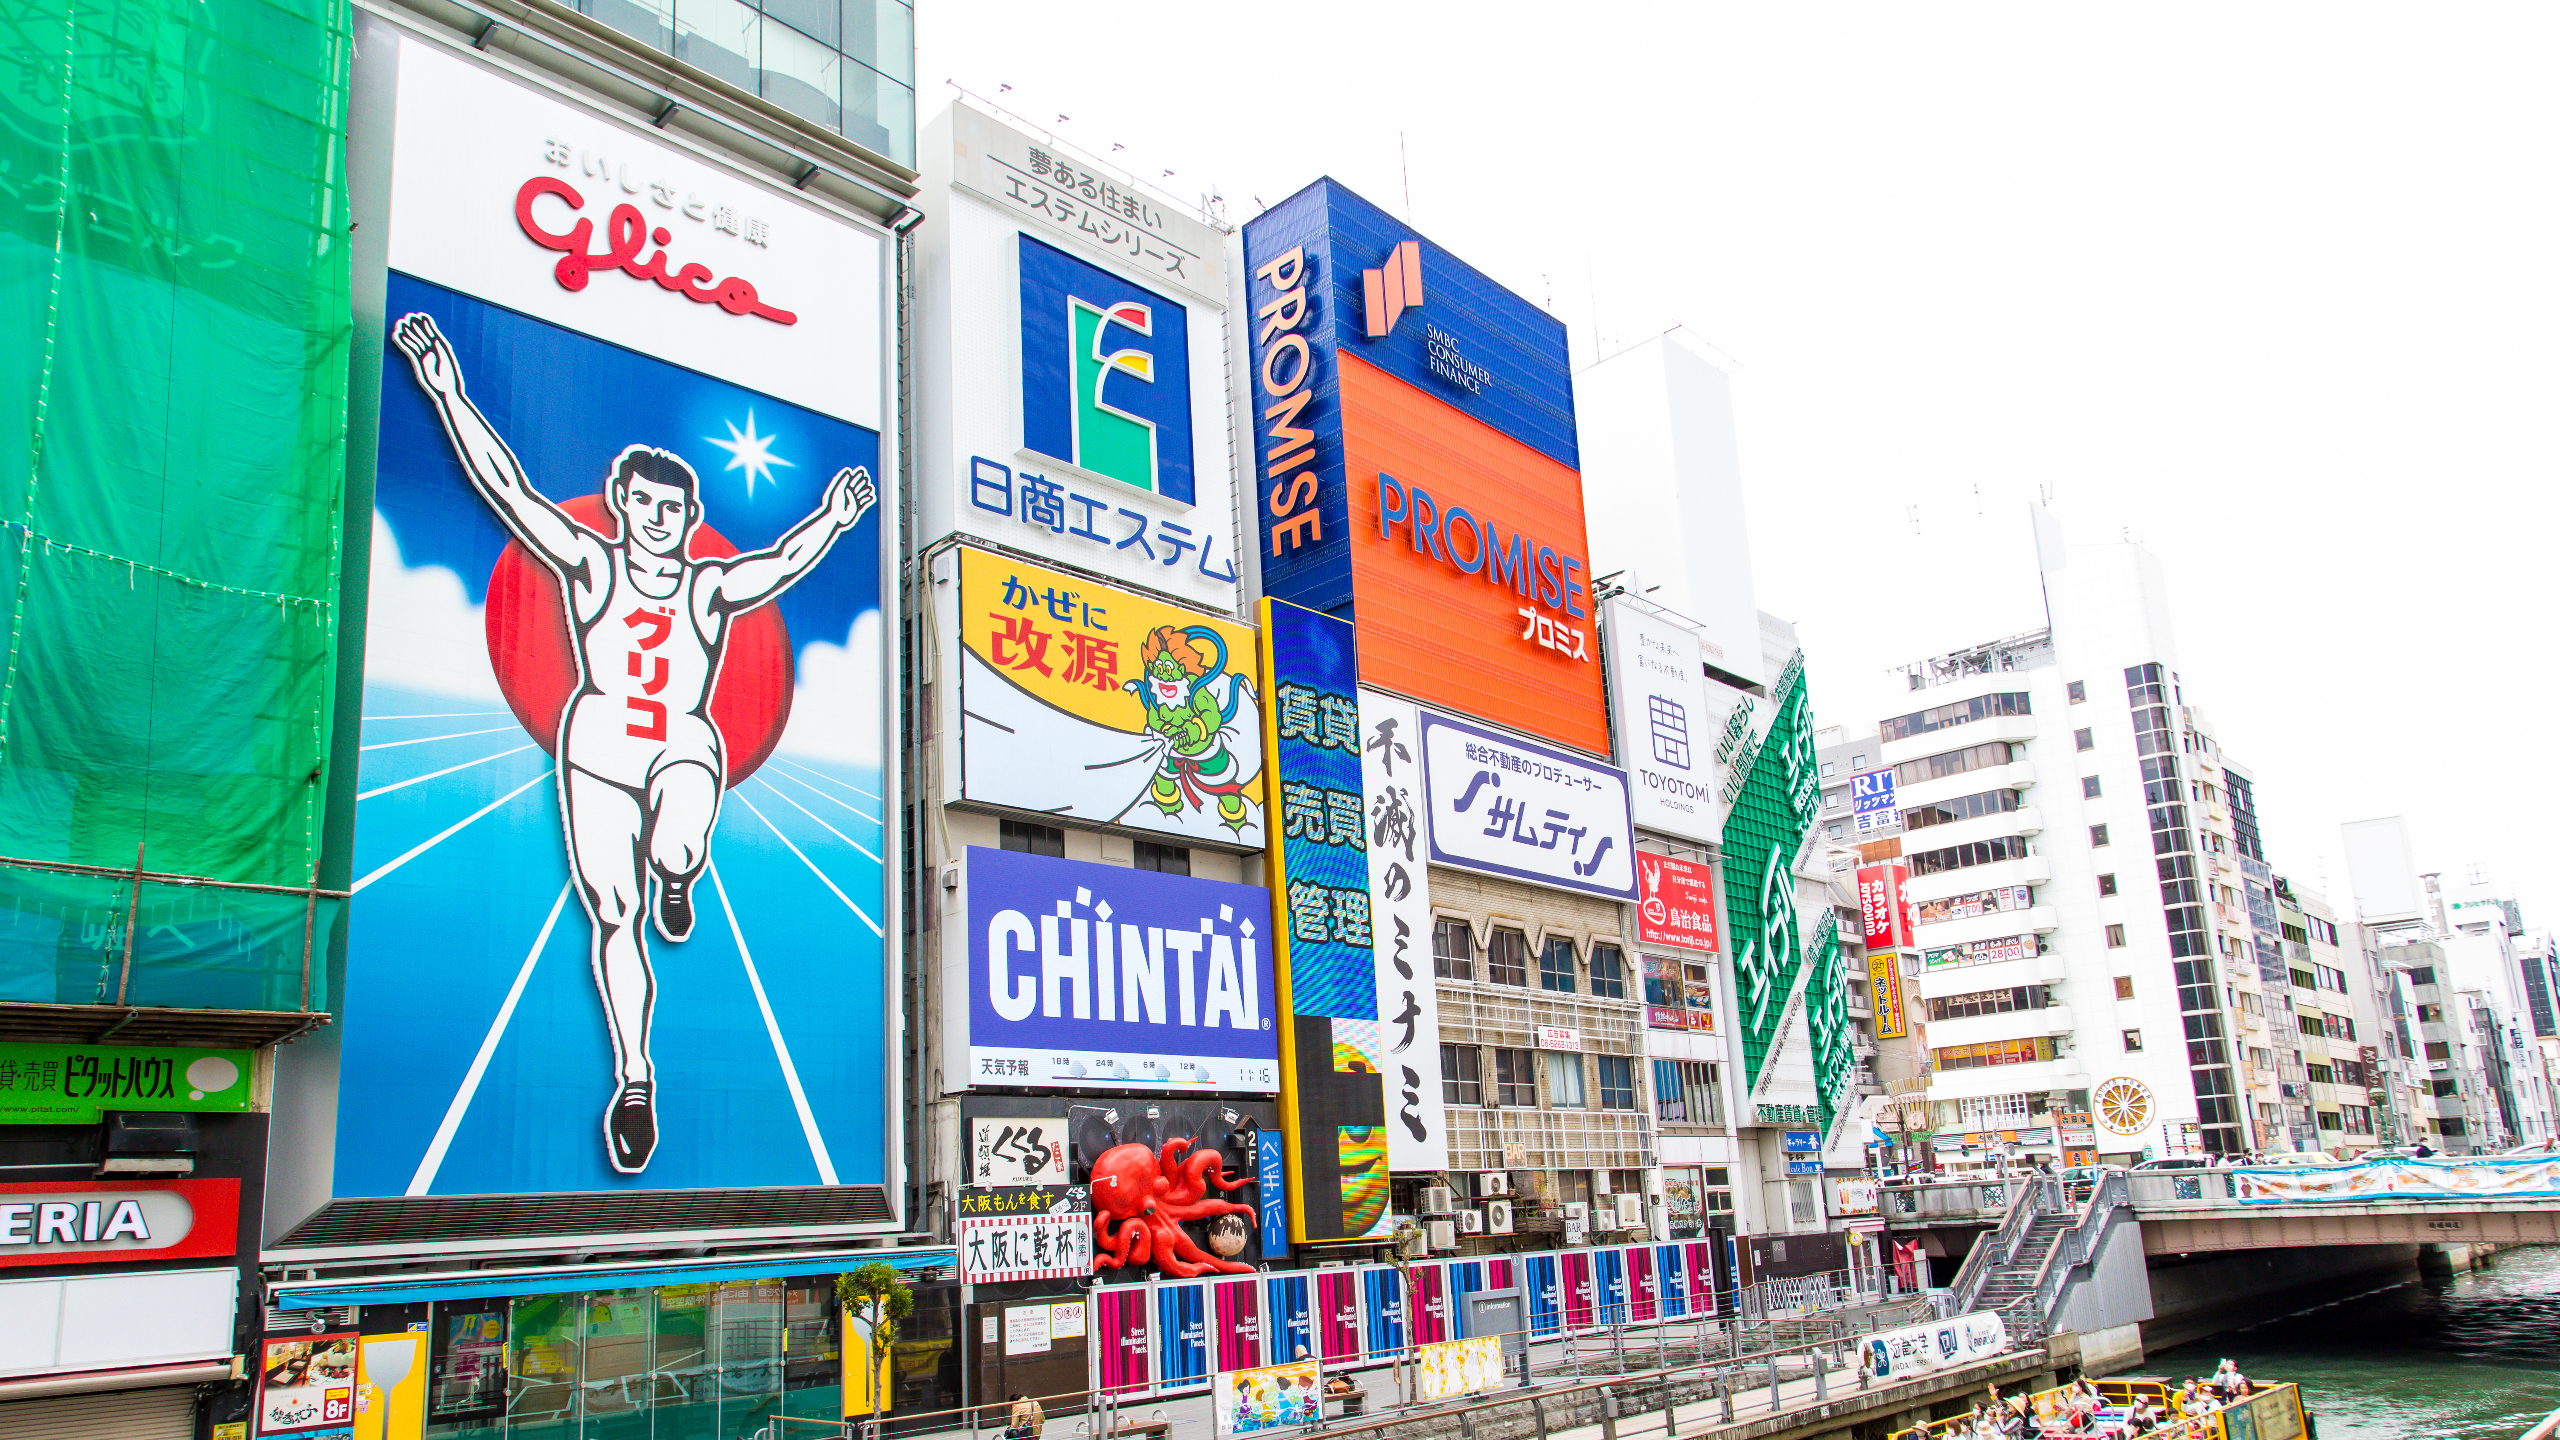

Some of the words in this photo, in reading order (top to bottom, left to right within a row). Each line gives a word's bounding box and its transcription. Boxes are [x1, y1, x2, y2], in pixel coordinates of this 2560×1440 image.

[544, 134, 770, 249] おいしさと健康
[1028, 146, 1163, 229] 夢ある住まい
[1005, 174, 1186, 280] エステムシリーズ
[1426, 323, 1460, 353] SMBC
[1428, 340, 1493, 388] CONSUMER
[1430, 355, 1481, 395] FINANCE
[1256, 245, 1323, 558] PROMISE
[971, 455, 1237, 584] 日商エステム
[1377, 471, 1585, 619] PROMISE
[1002, 574, 1108, 632] かぜに
[989, 612, 1121, 692] 改源
[1518, 606, 1589, 663] プロミス
[622, 606, 676, 742] グリコ
[1278, 683, 1360, 756] 賃貸
[1715, 694, 1755, 765] いい暮らし
[1465, 741, 1603, 792] 総合不動産のプロデューサー
[1722, 728, 1762, 805] いい部屋で
[1284, 782, 1365, 850] 売買
[1483, 796, 1588, 856] サムティ
[1660, 797, 1695, 814] HOLDINGS
[1289, 880, 1373, 946] 管理
[1366, 717, 1428, 1144] 不滅のミナミ
[1860, 882, 1876, 936] JOYSOUND
[1872, 879, 1890, 935] カラオケ
[1873, 976, 1894, 1035] ネットルーム
[64, 1055, 175, 1099] ピタットハウス
[981, 1058, 1029, 1077] 天気予報
[1052, 1058, 1070, 1066] 18時
[1096, 1059, 1114, 1067] 24時
[1143, 1061, 1155, 1069] 6時
[1180, 1063, 1196, 1071] 12時
[1756, 1103, 1824, 1123] 不動産賃貸・管理
[978, 1124, 991, 1179] 道頓堀
[991, 1125, 1051, 1175] くくる
[1801, 1163, 1813, 1173] Bon
[962, 1191, 1055, 1213] 大阪もんを食す
[1073, 1202, 1088, 1212] 2F
[1262, 1140, 1282, 1246] ペンギンバー
[968, 1225, 1074, 1273] 大阪に乾杯
[1077, 1230, 1087, 1258] 検索
[1566, 1222, 1582, 1233] BAR
[1189, 1322, 1203, 1330] Street
[1244, 1316, 1257, 1324] Street
[1296, 1310, 1308, 1319] Street
[1486, 1301, 1511, 1311] information
[1131, 1328, 1145, 1337] Street
[326, 1400, 348, 1419] 8F
